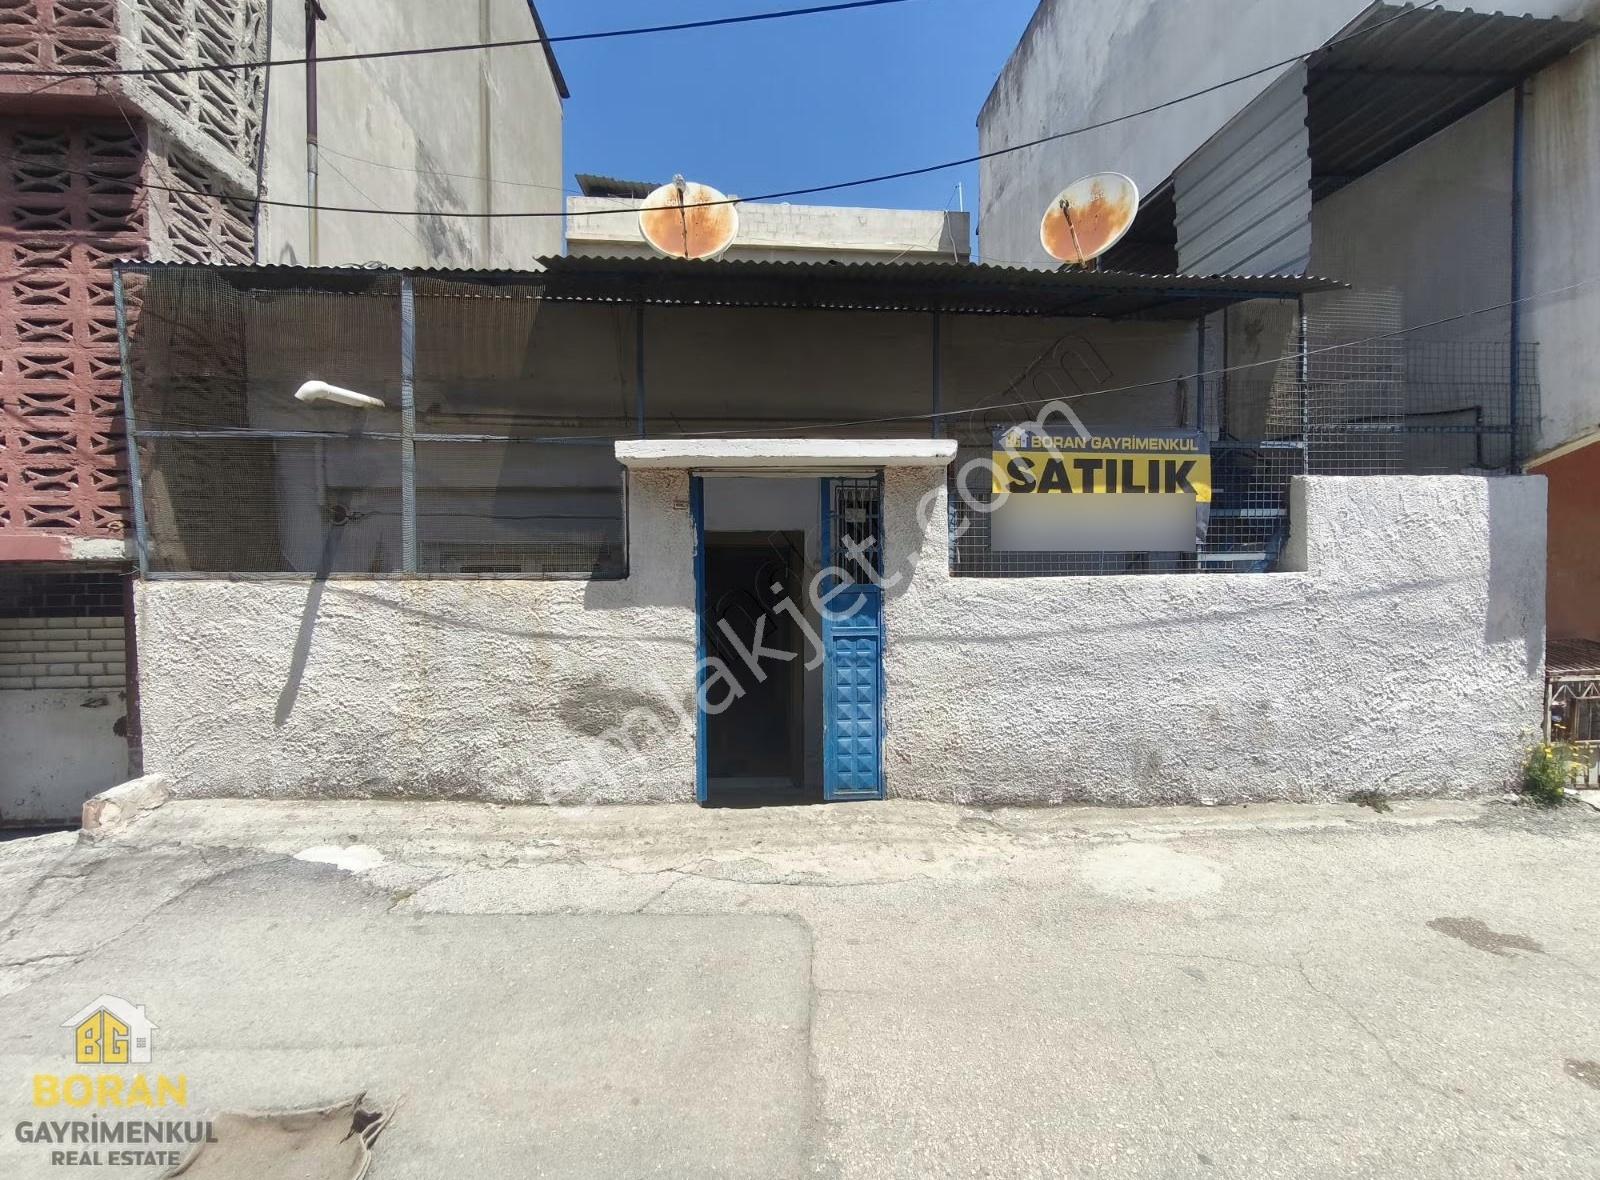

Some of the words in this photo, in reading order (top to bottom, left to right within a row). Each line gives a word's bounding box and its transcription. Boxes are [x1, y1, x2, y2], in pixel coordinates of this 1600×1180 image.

[1031, 435, 1086, 449] BORAN
[1091, 435, 1199, 451] GAYRİMENKUL
[1006, 457, 1198, 495] SATILIK
